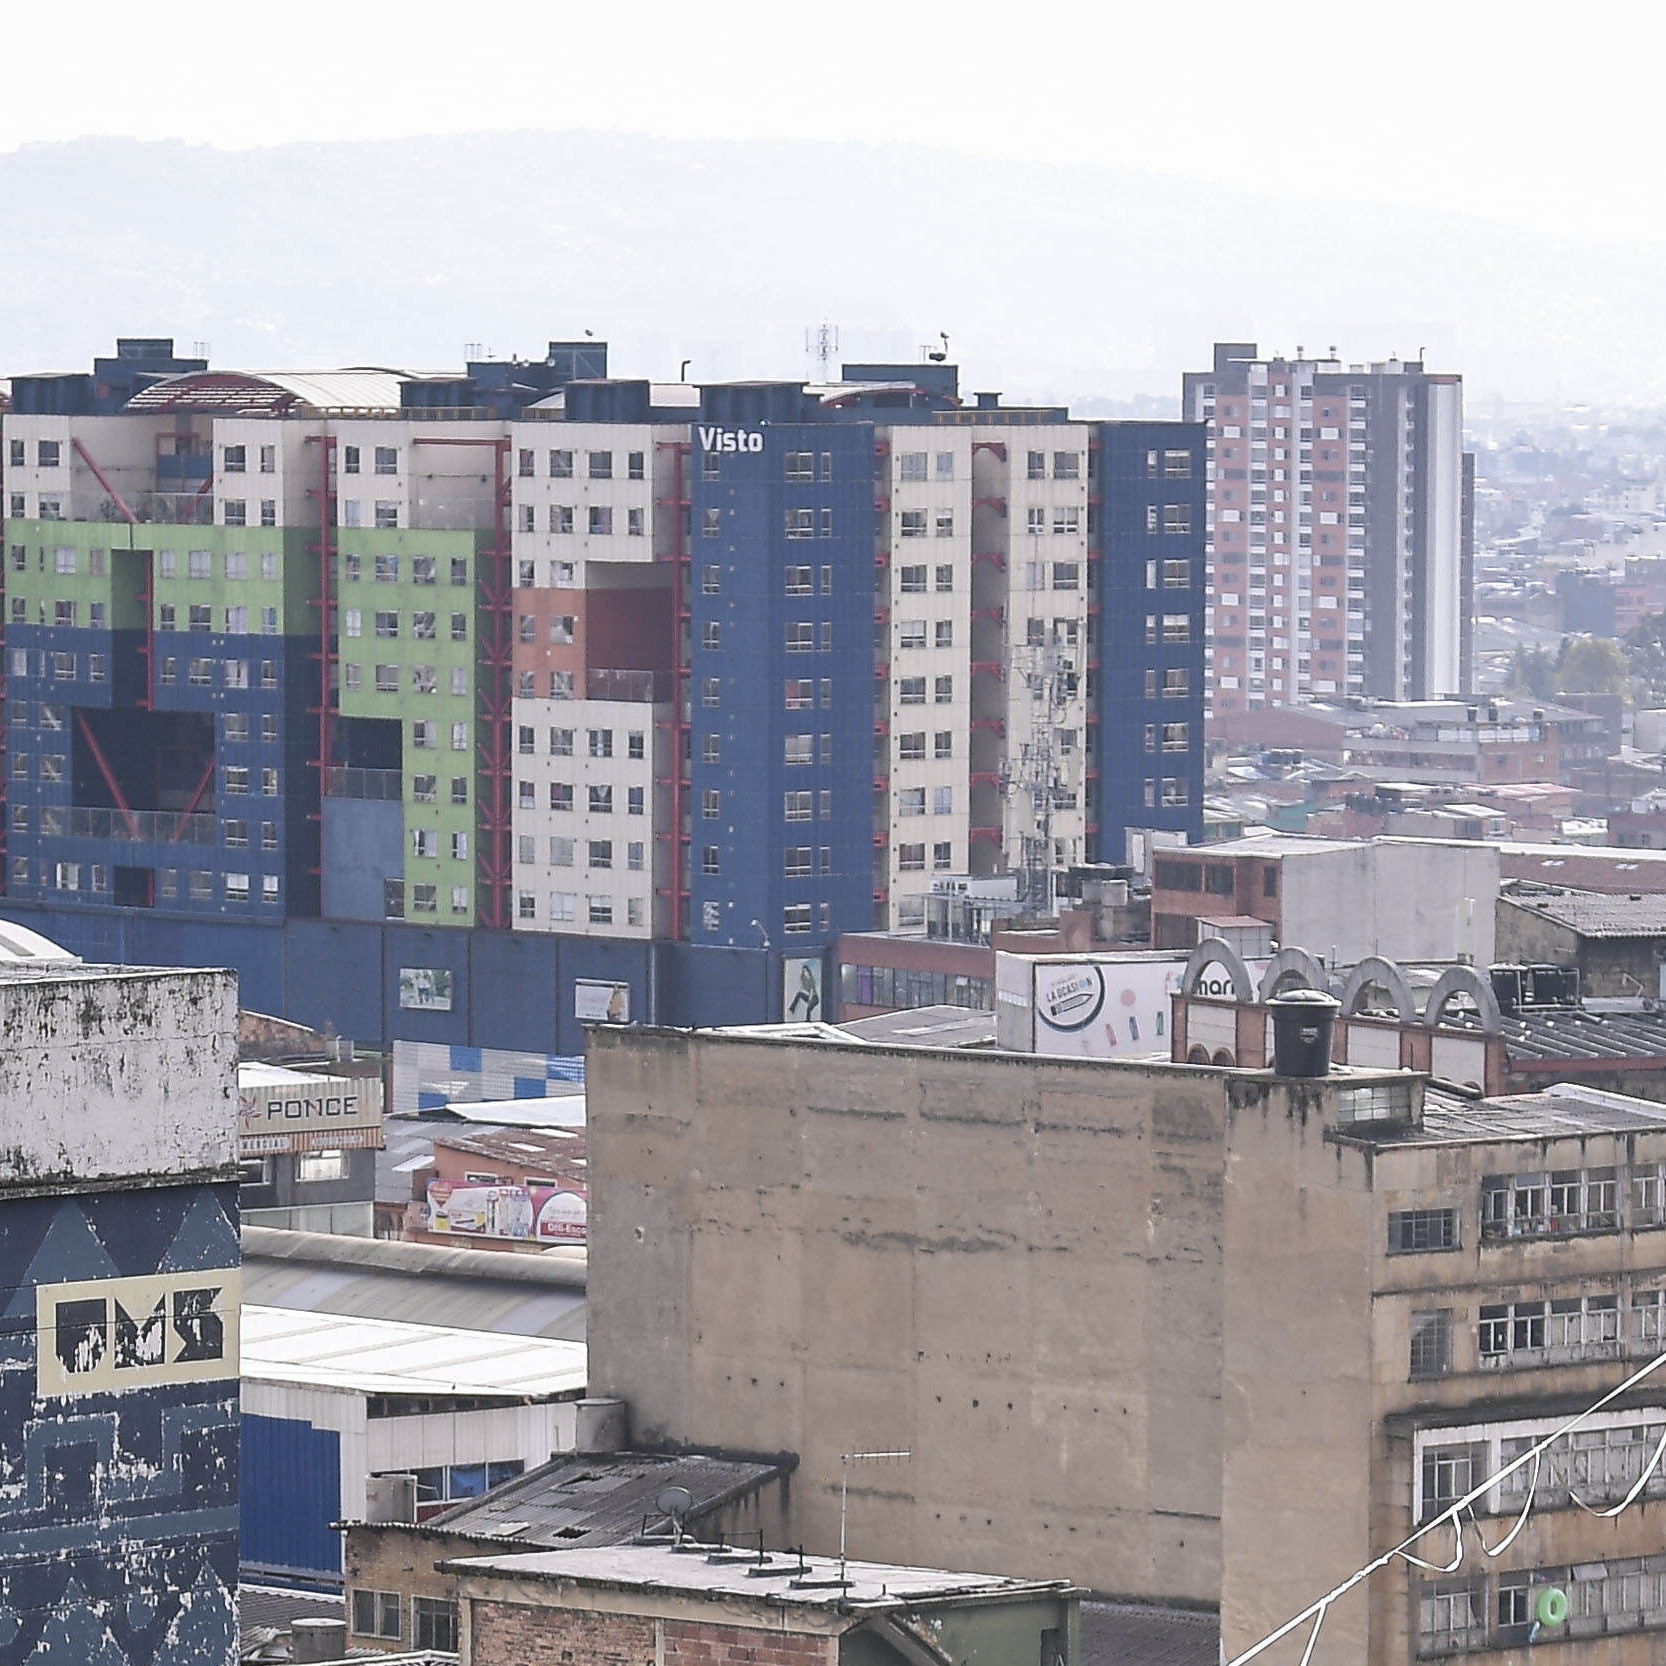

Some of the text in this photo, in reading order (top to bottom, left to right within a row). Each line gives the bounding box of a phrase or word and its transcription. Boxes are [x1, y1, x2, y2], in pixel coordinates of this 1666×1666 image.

[698, 426, 764, 452] Visto
[267, 1096, 358, 1120] PONCE
[241, 1138, 288, 1150] MERCIAL
